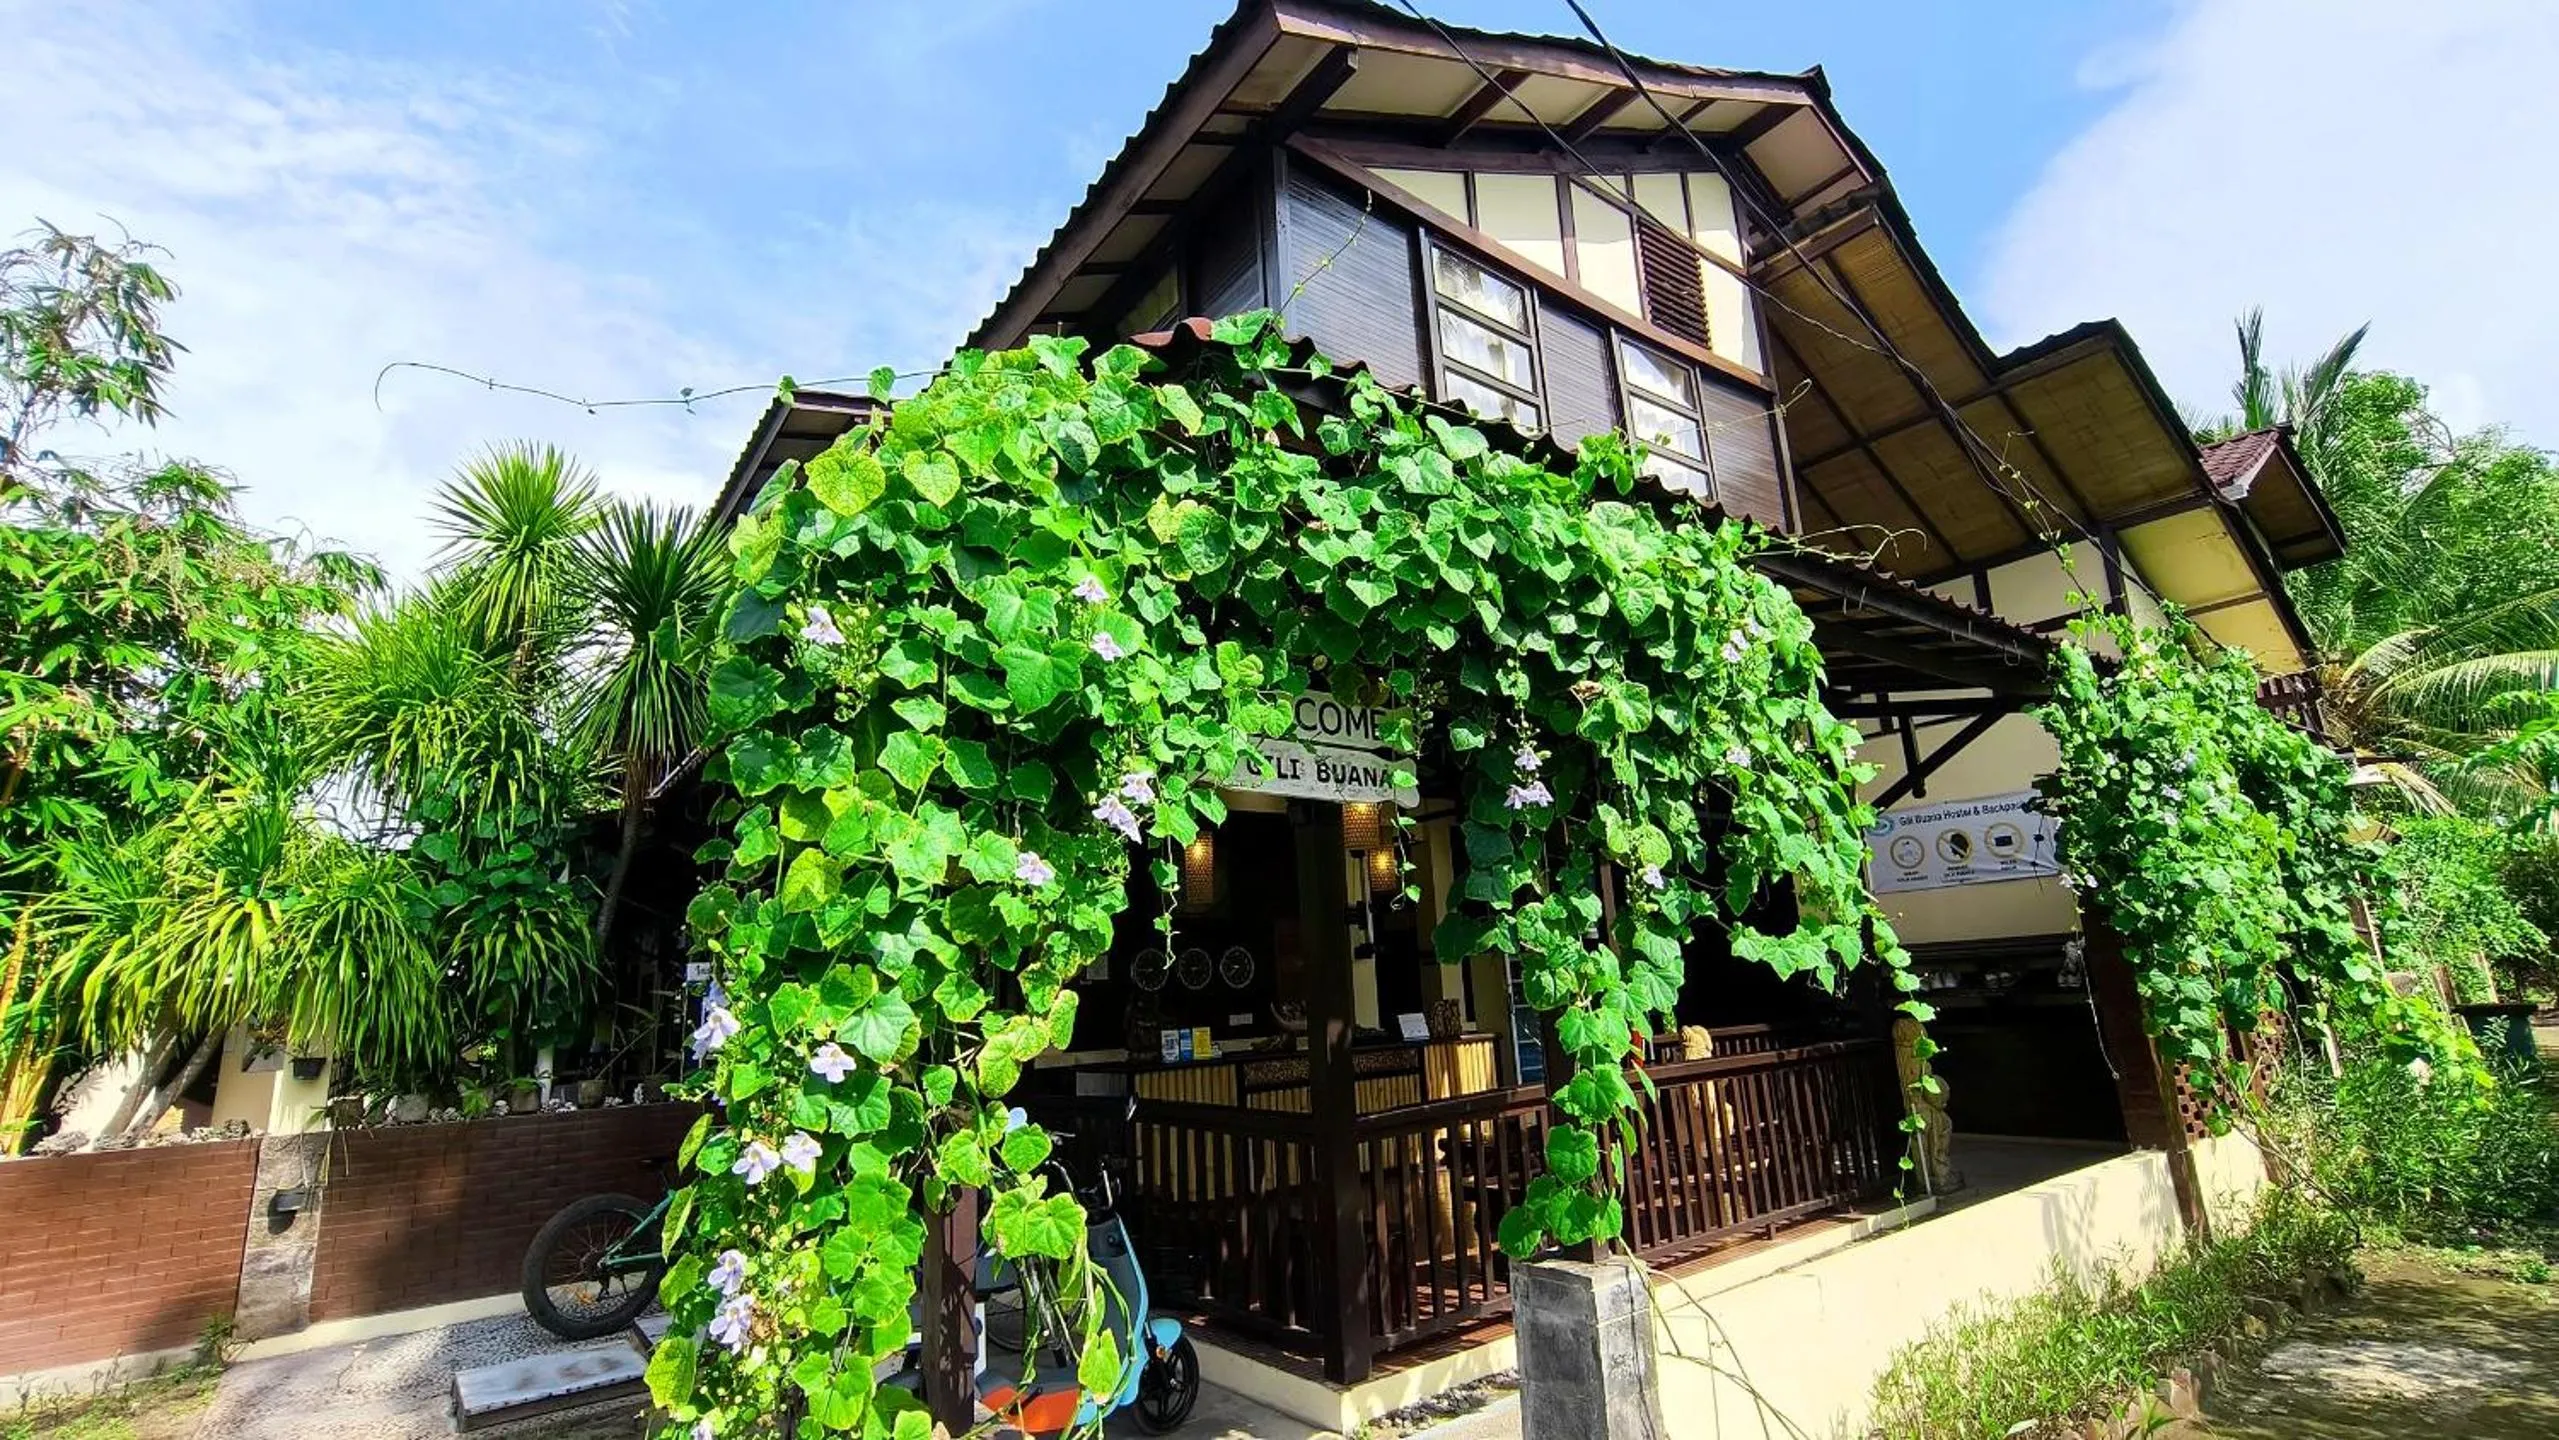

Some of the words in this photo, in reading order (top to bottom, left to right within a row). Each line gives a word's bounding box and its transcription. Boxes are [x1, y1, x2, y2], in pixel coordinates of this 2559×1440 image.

[1295, 698, 1387, 741] COME
[1317, 762, 1393, 788] BUANA
[1943, 807, 1971, 820] Hostel
[1973, 806, 1980, 816] &
